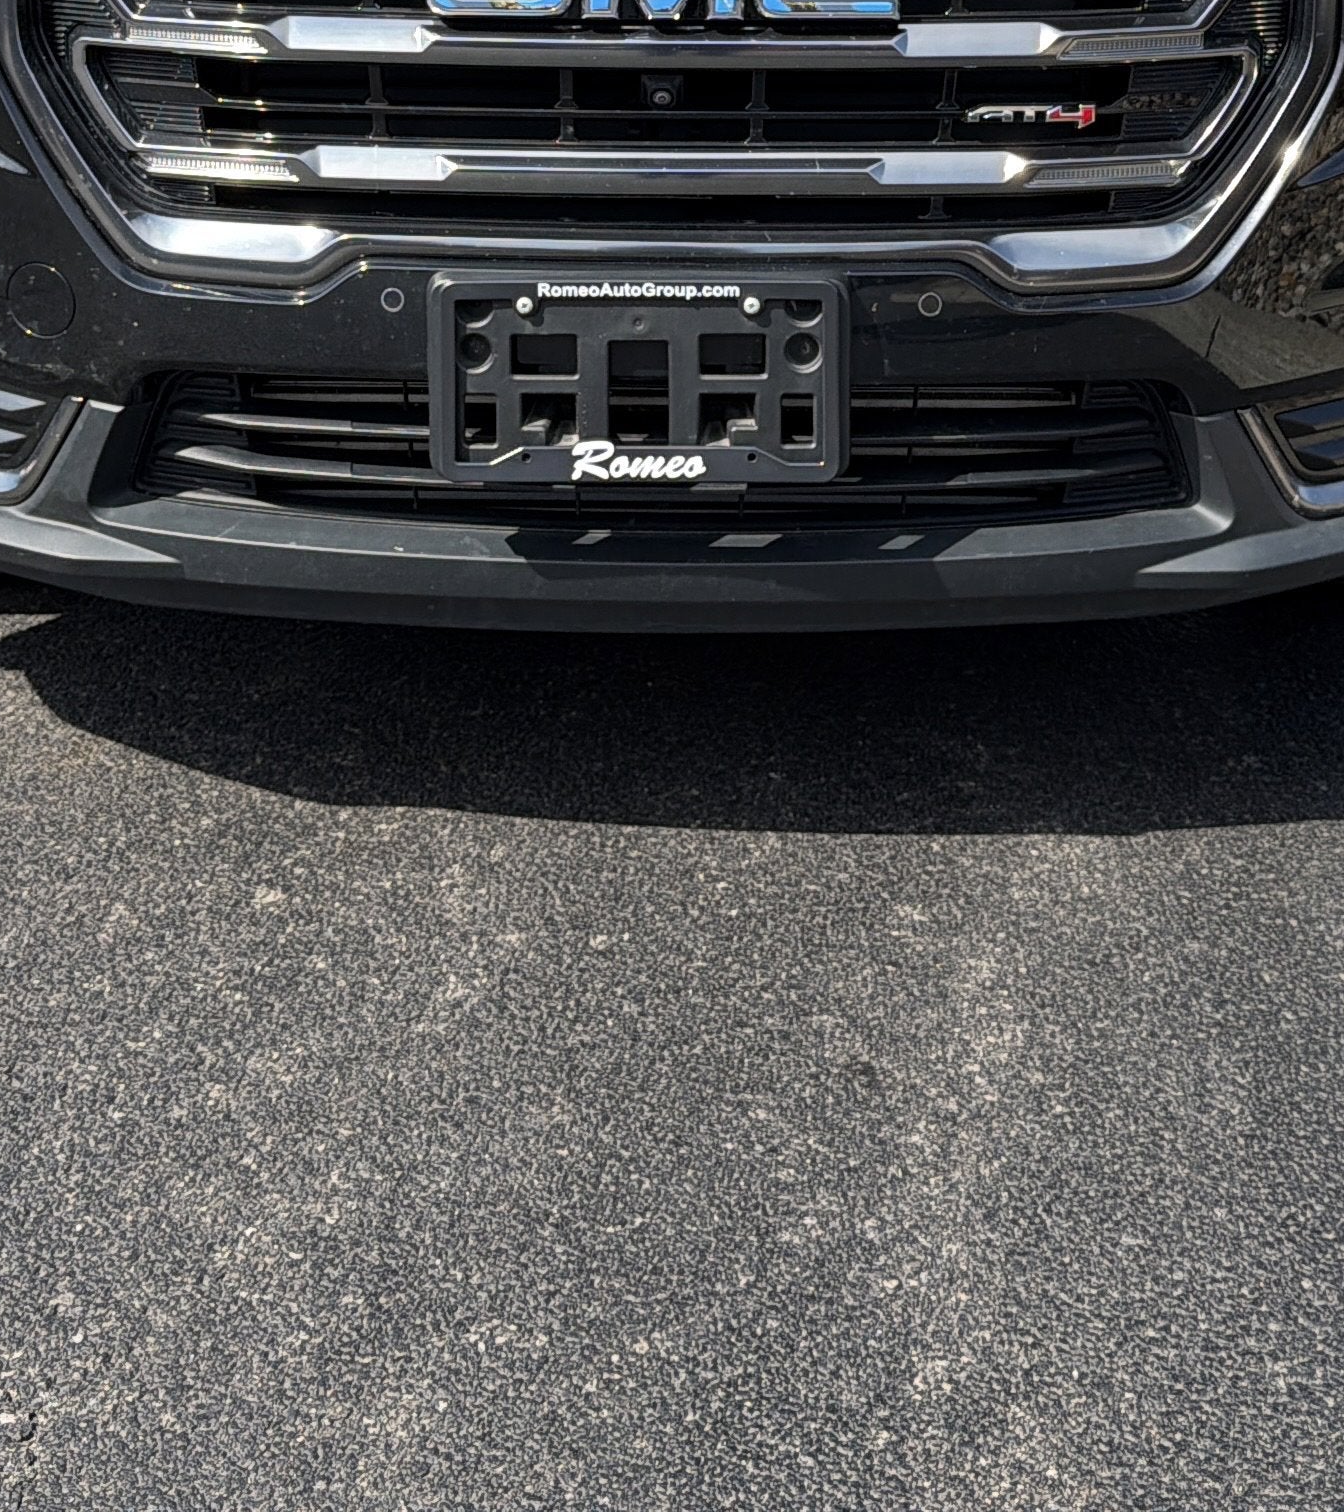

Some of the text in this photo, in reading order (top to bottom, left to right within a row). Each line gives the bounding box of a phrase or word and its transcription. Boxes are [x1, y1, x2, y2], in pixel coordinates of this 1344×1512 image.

[965, 104, 1096, 129] AT4
[536, 281, 741, 301] RomeoAutoGroup.com
[571, 440, 707, 481] Romeo
